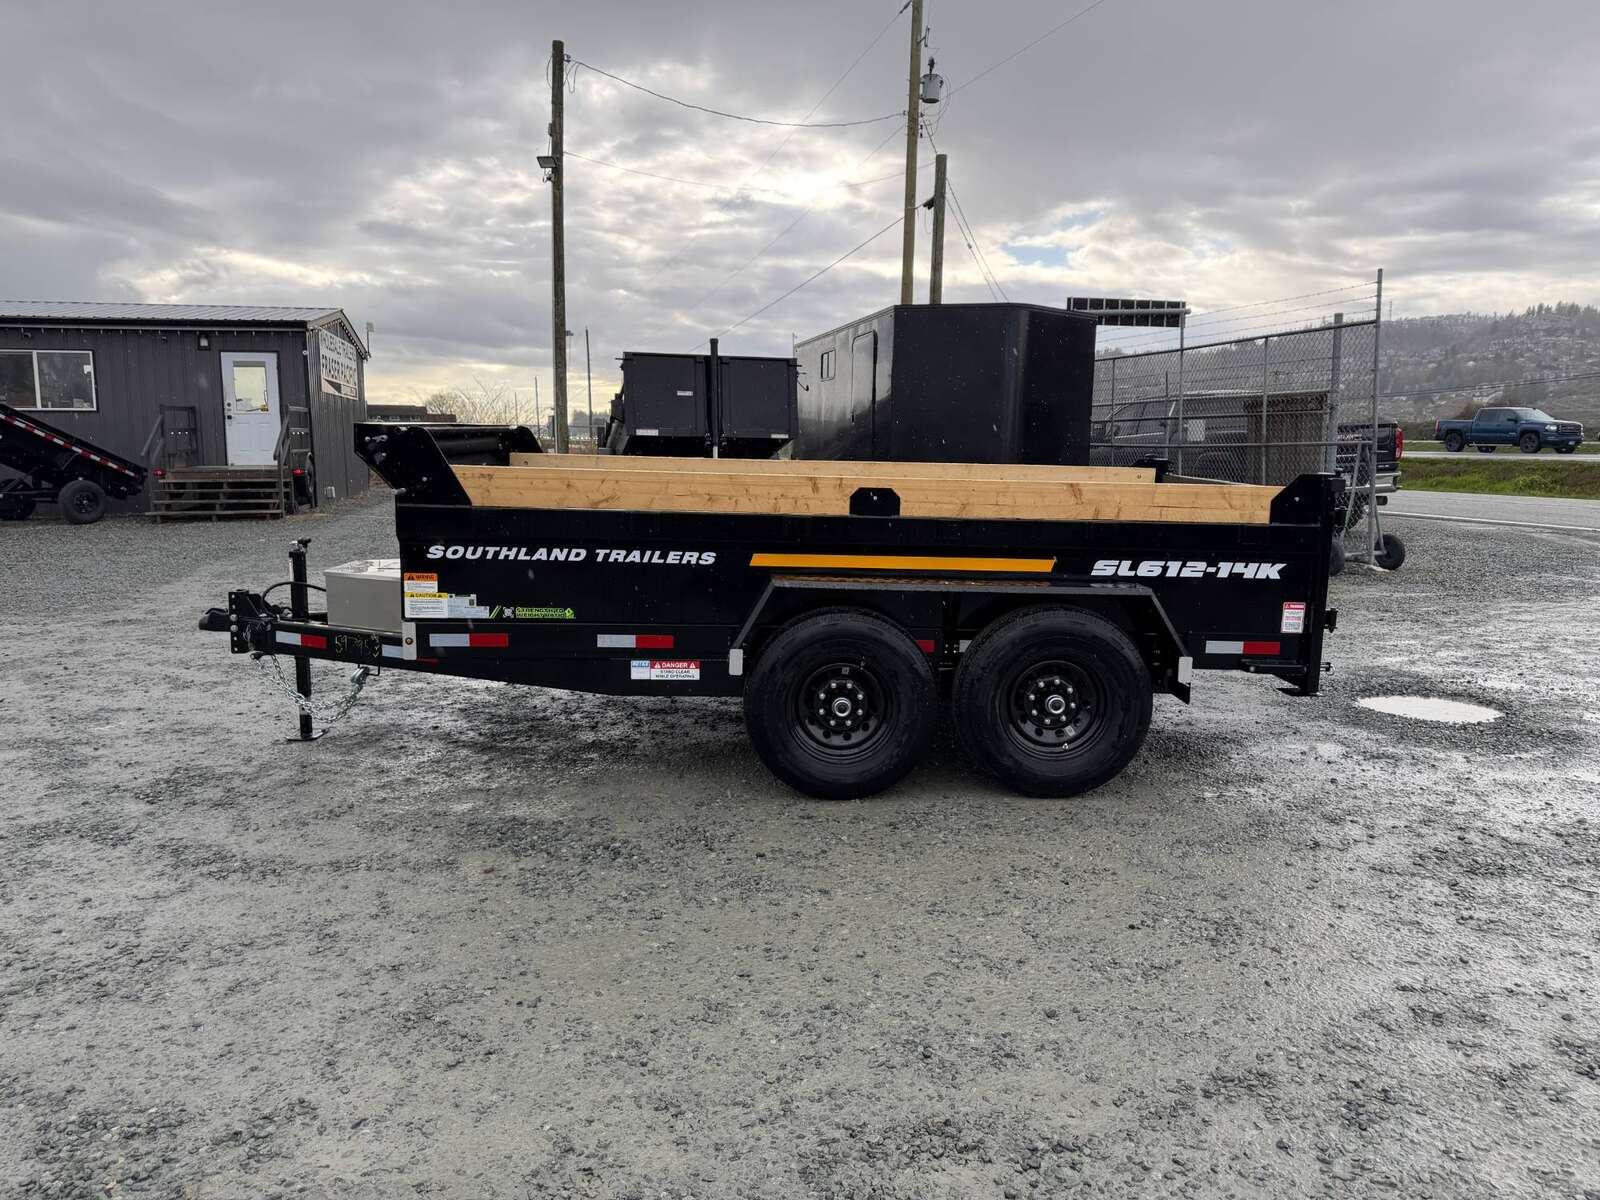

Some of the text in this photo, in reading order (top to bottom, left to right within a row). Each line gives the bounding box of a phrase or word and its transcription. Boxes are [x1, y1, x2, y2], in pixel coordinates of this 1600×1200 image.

[426, 544, 717, 565] SOUTHLAND TRAILERS
[1090, 559, 1288, 580] SL612-14K
